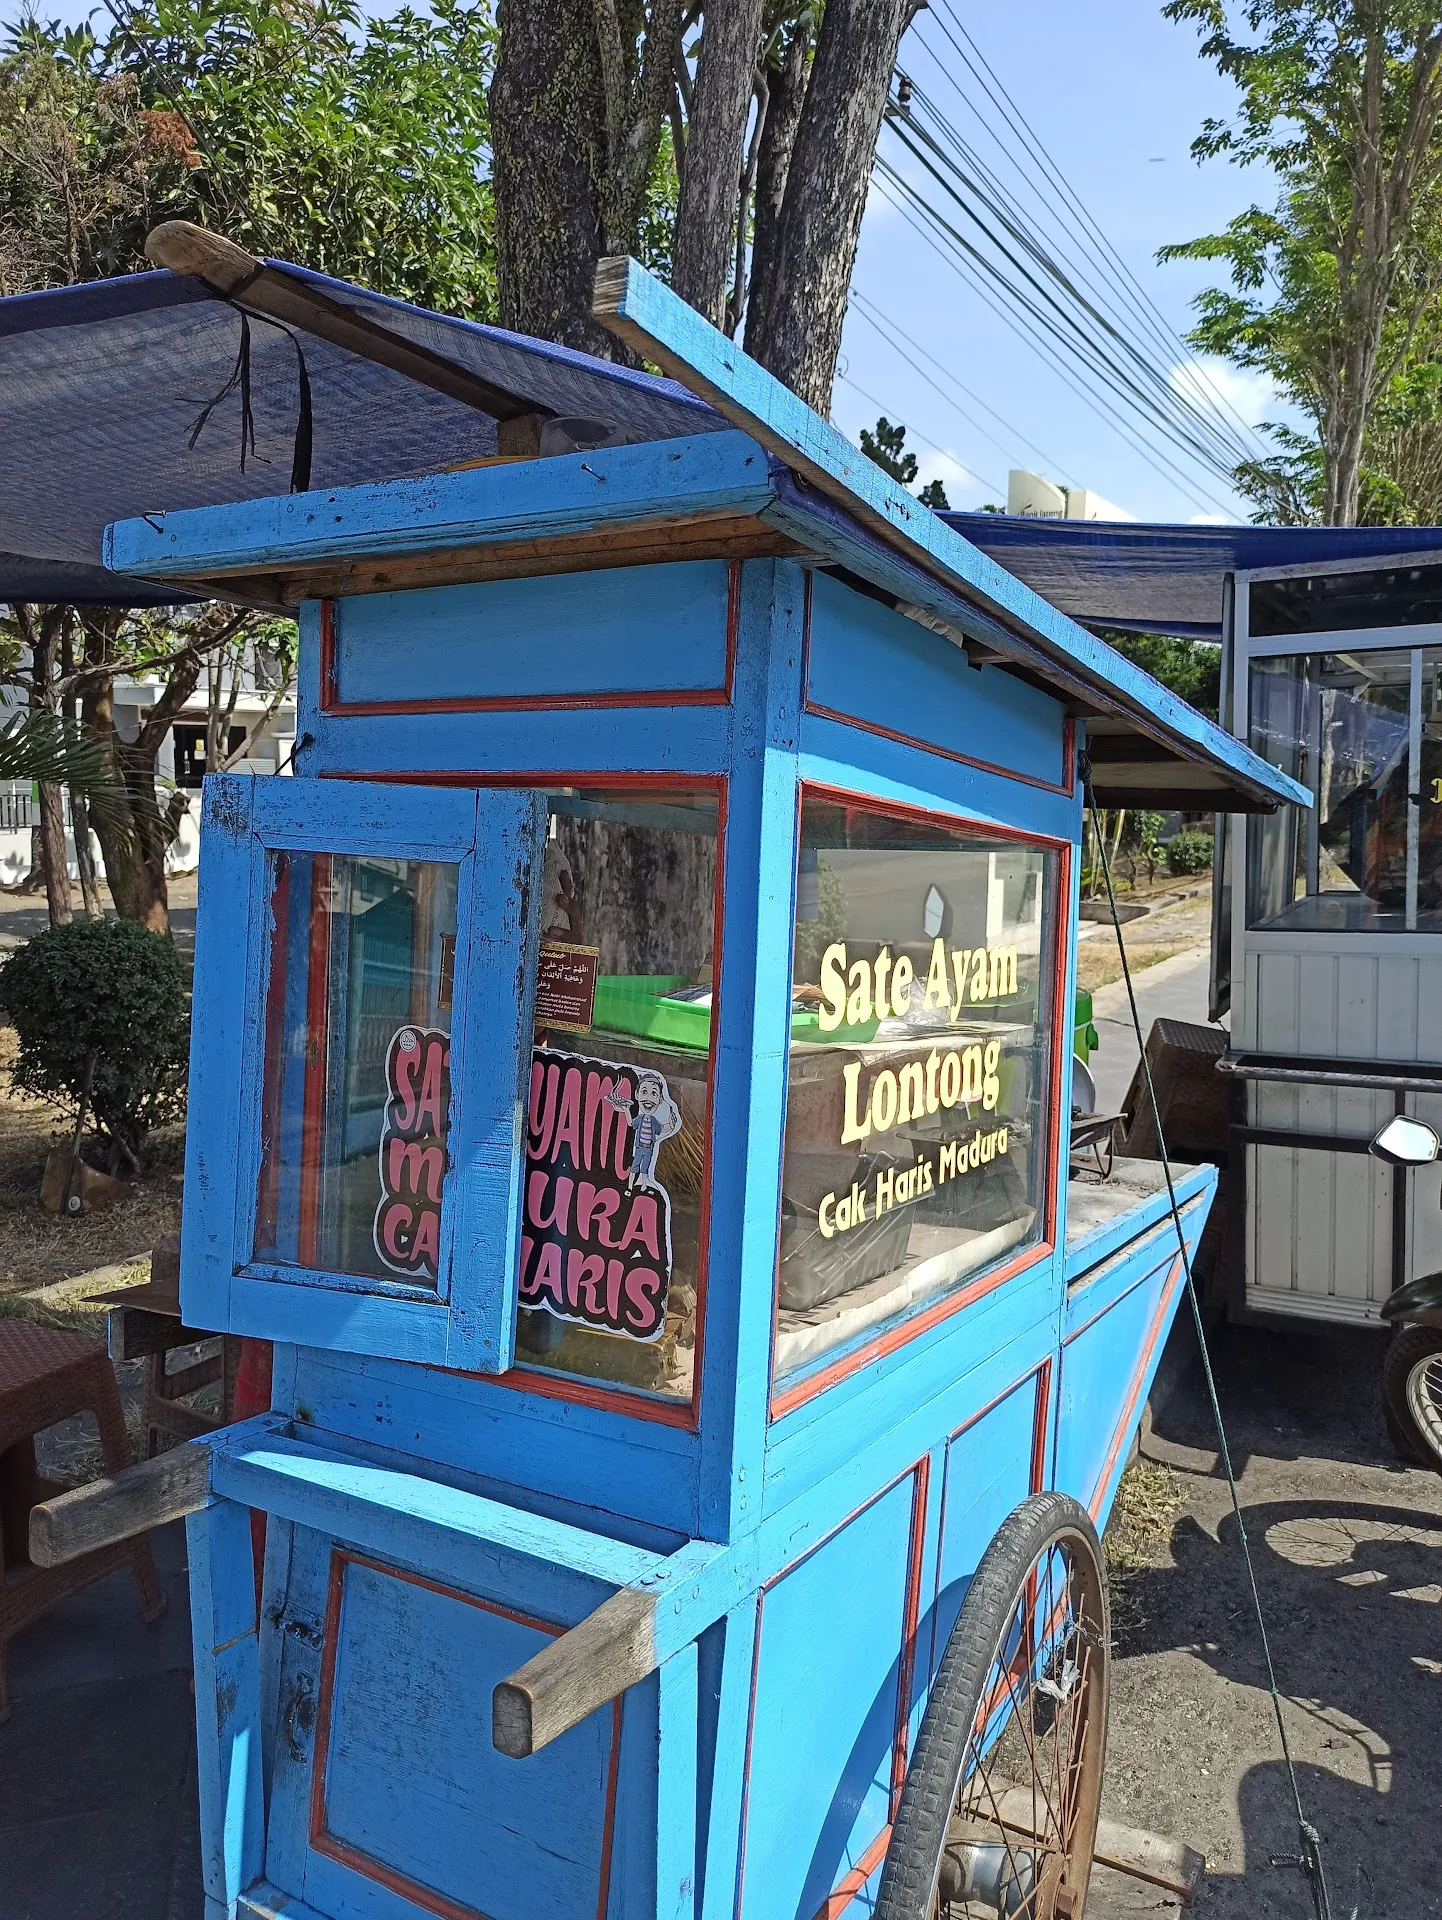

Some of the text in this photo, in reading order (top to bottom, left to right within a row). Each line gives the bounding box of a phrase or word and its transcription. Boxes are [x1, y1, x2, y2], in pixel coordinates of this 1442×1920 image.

[818, 937, 1018, 1032] Sate Ayam
[527, 1061, 633, 1181] YAM
[841, 1039, 1001, 1145] Lontong
[818, 1127, 1008, 1238] Cak Haris Madura
[384, 1204, 439, 1269] CA
